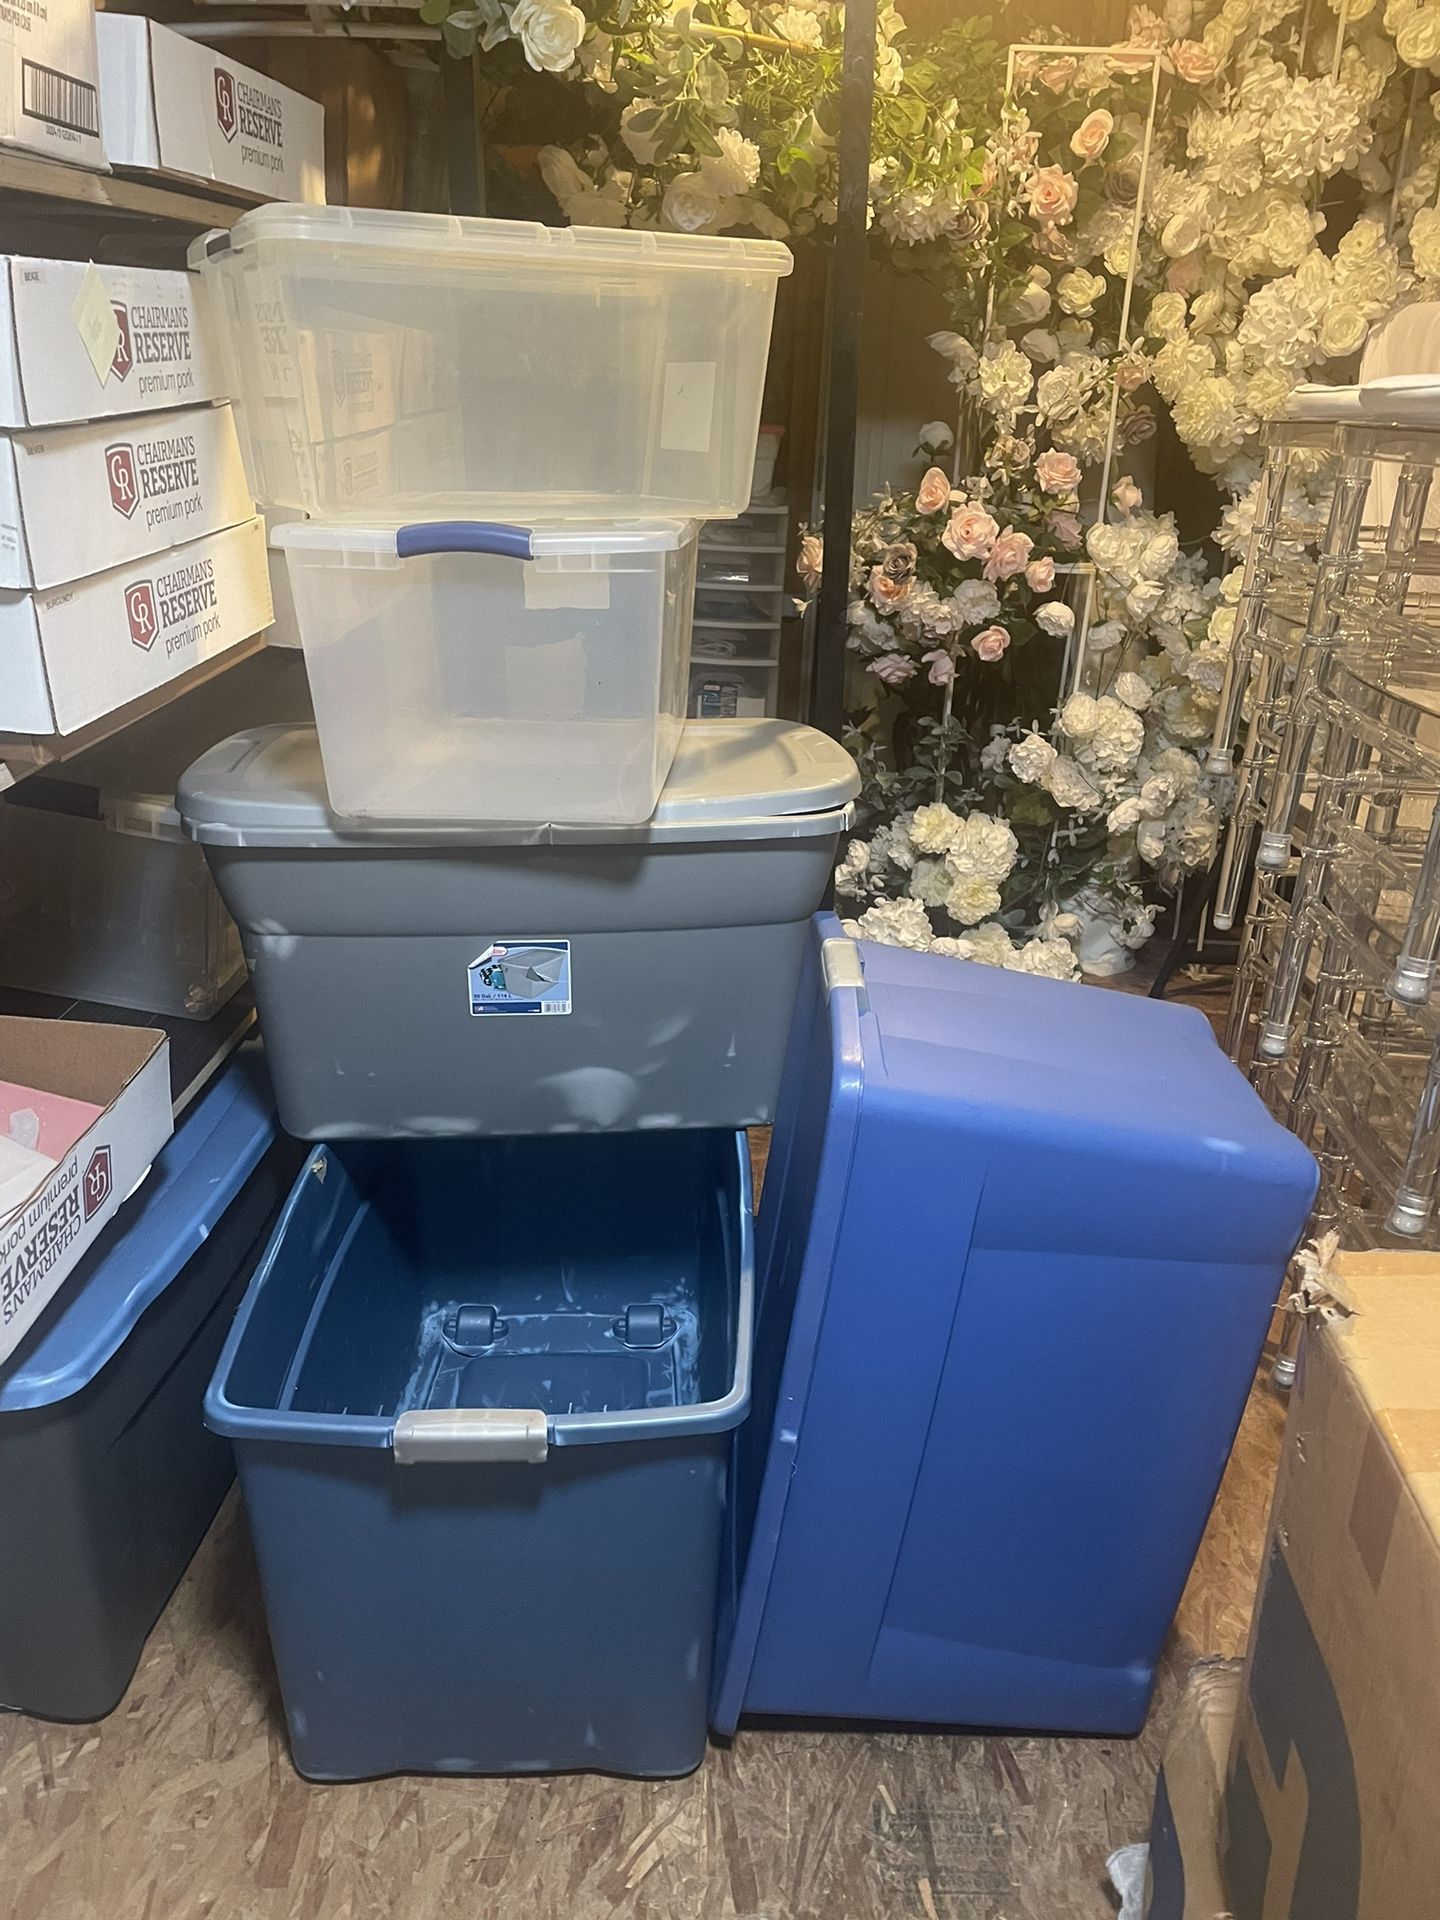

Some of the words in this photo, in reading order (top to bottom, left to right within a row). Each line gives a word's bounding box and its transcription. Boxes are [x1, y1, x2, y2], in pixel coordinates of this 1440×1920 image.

[238, 104, 283, 148] RESERVE
[241, 145, 270, 168] premium
[270, 155, 285, 174] pork
[133, 331, 192, 364] RESERVE
[139, 369, 176, 399] premium
[176, 367, 195, 394] pork
[139, 458, 200, 499] RESERVE
[146, 501, 184, 532] premium
[184, 492, 203, 520] pork
[159, 579, 218, 629] RESERVE
[165, 625, 203, 660] premium
[202, 611, 221, 640] pork
[29, 1156, 78, 1228] premium
[1, 1184, 80, 1300] RESERVE
